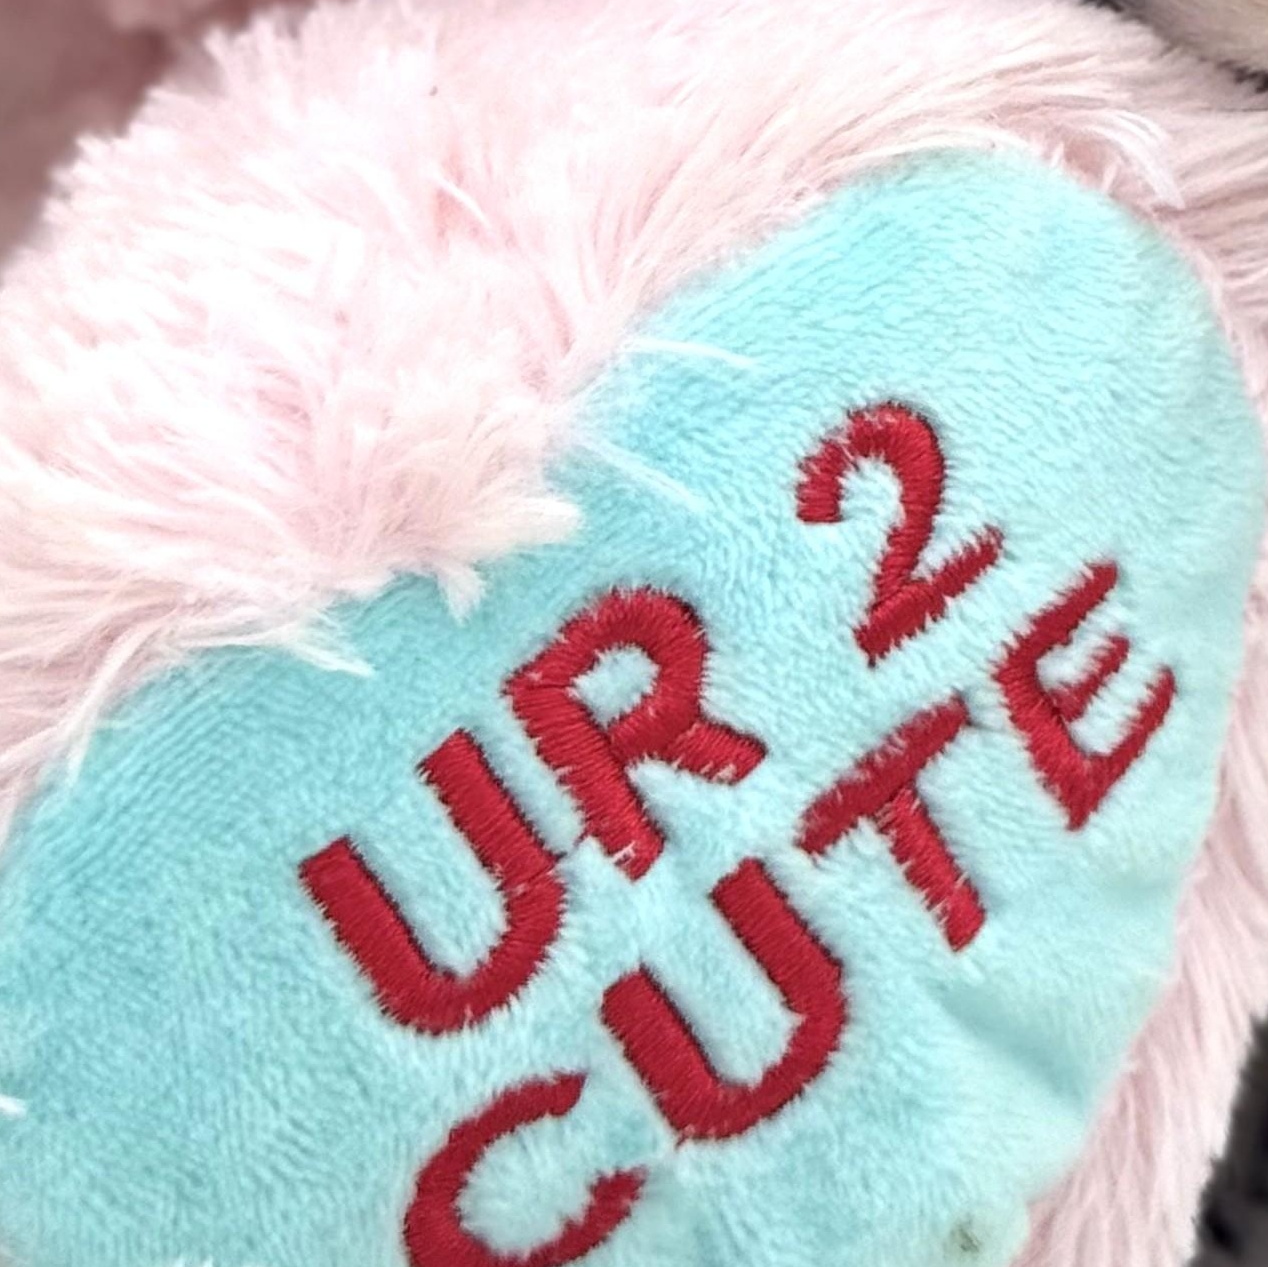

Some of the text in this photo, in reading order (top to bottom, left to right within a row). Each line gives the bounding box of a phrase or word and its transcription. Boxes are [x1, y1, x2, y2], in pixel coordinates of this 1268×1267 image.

[299, 401, 1002, 1036] UR 2
[402, 559, 1176, 1267] CUTE
